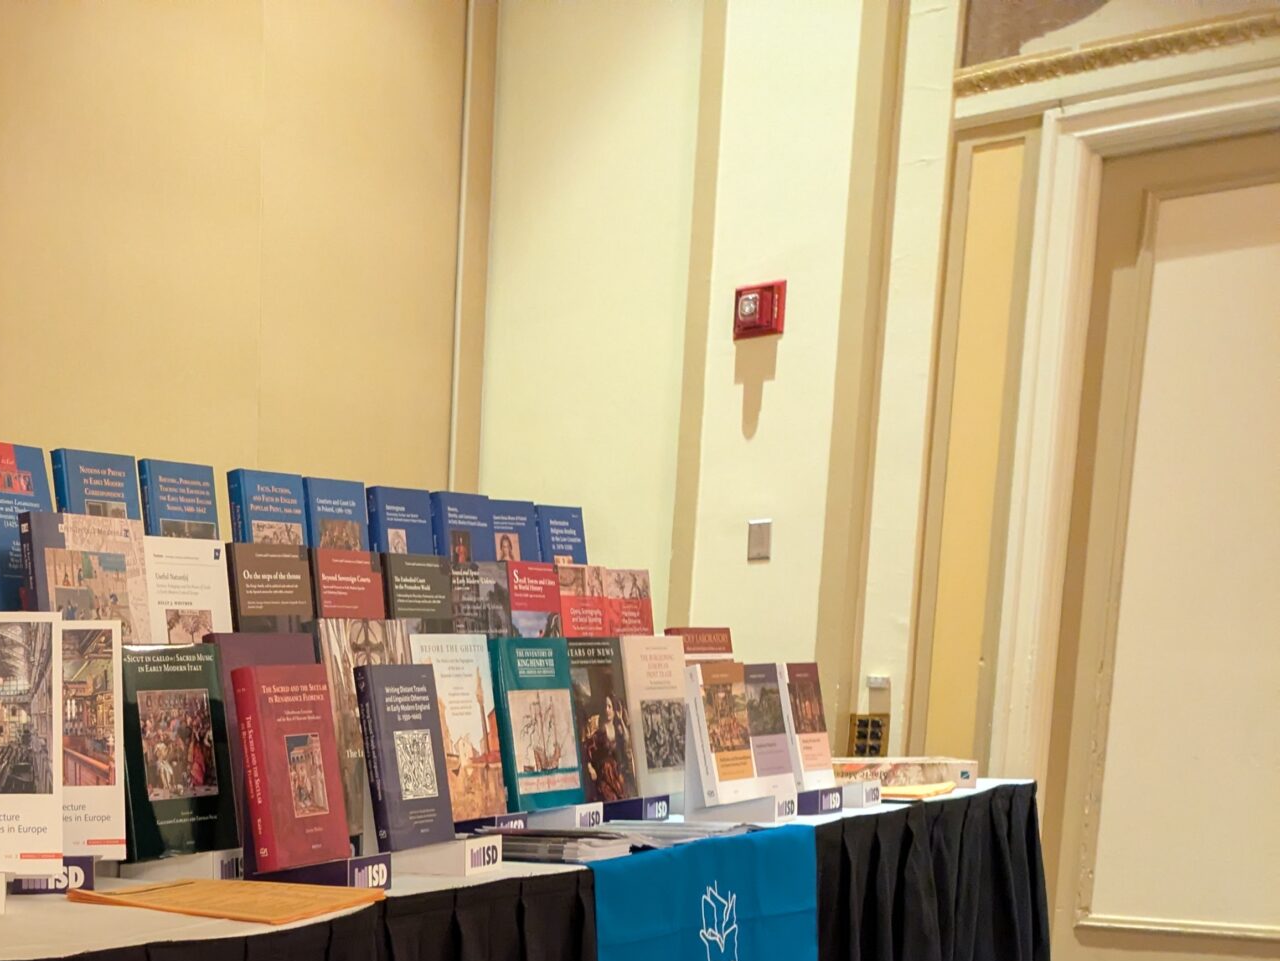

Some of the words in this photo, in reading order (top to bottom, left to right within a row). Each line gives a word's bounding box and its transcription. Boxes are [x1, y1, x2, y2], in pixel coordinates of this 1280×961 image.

[243, 569, 252, 580] On
[273, 571, 278, 579] of
[420, 645, 444, 653] BEFORE
[447, 645, 458, 653] THE
[587, 648, 595, 656] OF
[597, 648, 614, 656] NEWS
[175, 654, 196, 662] SACRED
[196, 653, 214, 661] MUSIC
[164, 664, 186, 672] MODERN
[187, 663, 202, 671] ITALY
[830, 792, 840, 809] ISD
[655, 802, 667, 817] ISD
[74, 814, 82, 822] in
[84, 814, 111, 823] Europe
[589, 810, 600, 827] ISD
[8, 825, 15, 833] in
[18, 825, 47, 835] Europe
[483, 848, 498, 864] ISD
[368, 864, 387, 887] ISD
